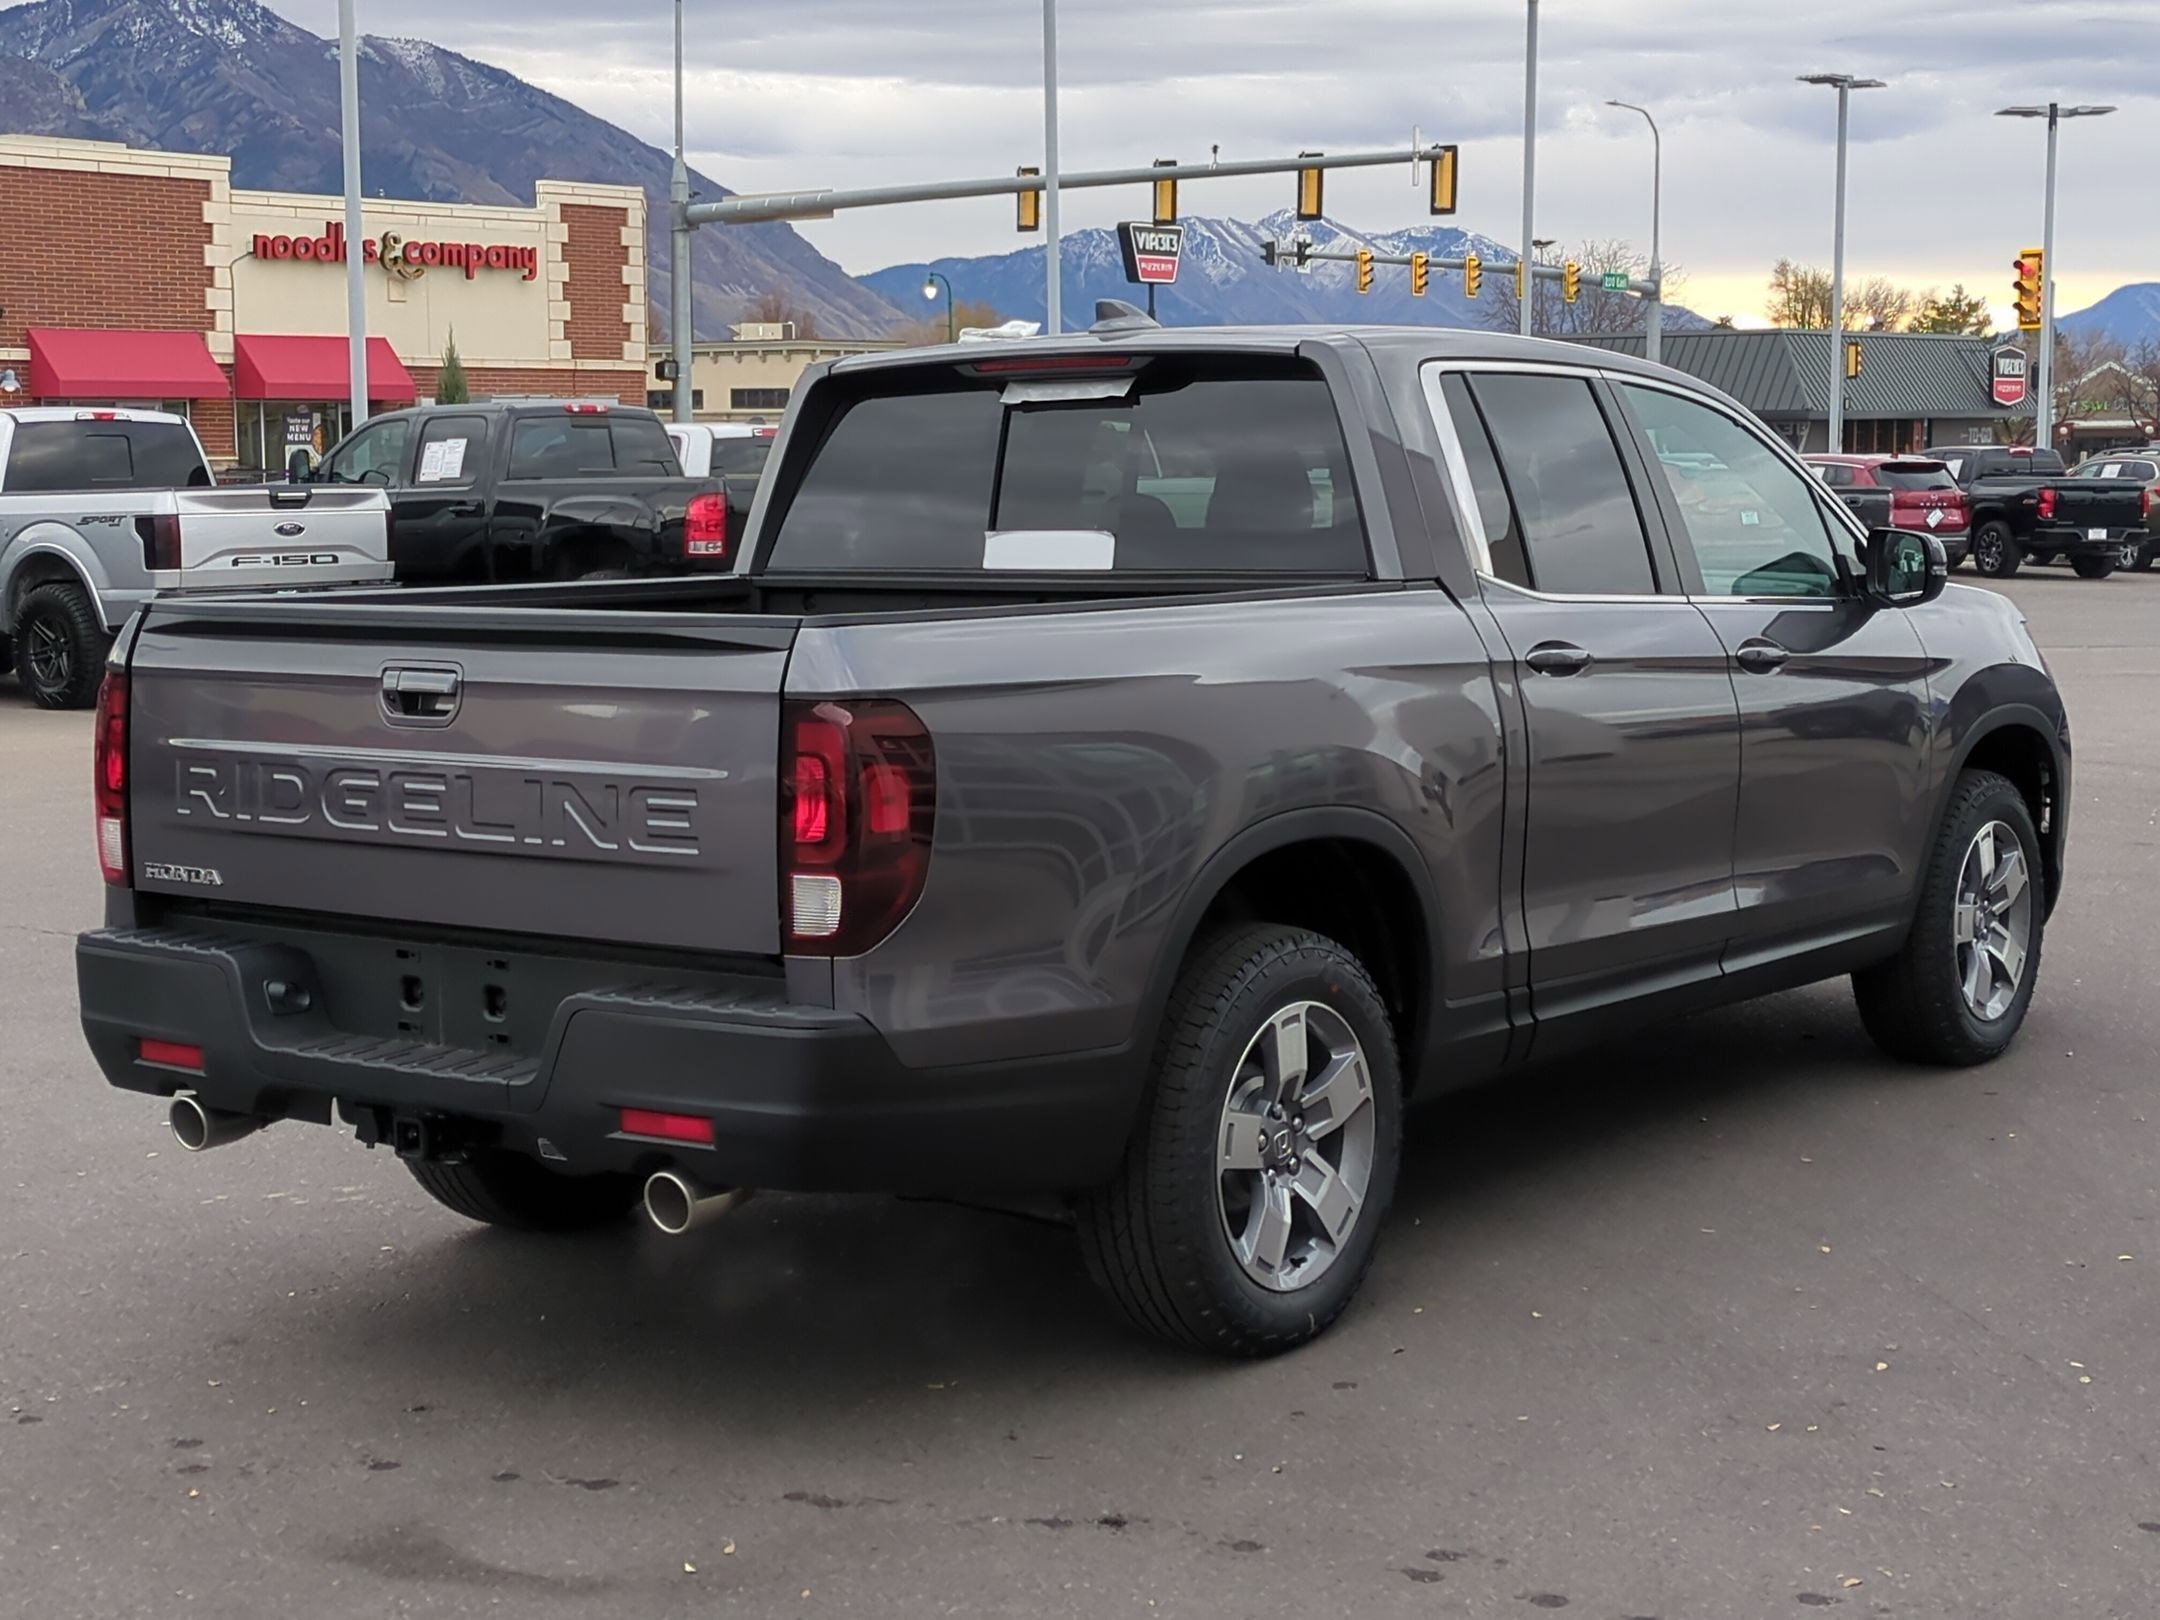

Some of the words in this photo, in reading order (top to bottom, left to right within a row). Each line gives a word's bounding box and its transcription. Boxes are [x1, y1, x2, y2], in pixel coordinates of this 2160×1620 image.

[253, 221, 376, 262] noodls
[380, 231, 425, 280] &
[403, 240, 538, 281] company
[288, 424, 309, 433] NEW
[286, 433, 312, 442] MENU
[76, 515, 127, 526] SPORT
[232, 553, 339, 568] F-150
[174, 757, 700, 855] RIDGELINE
[143, 861, 224, 887] HONDA
